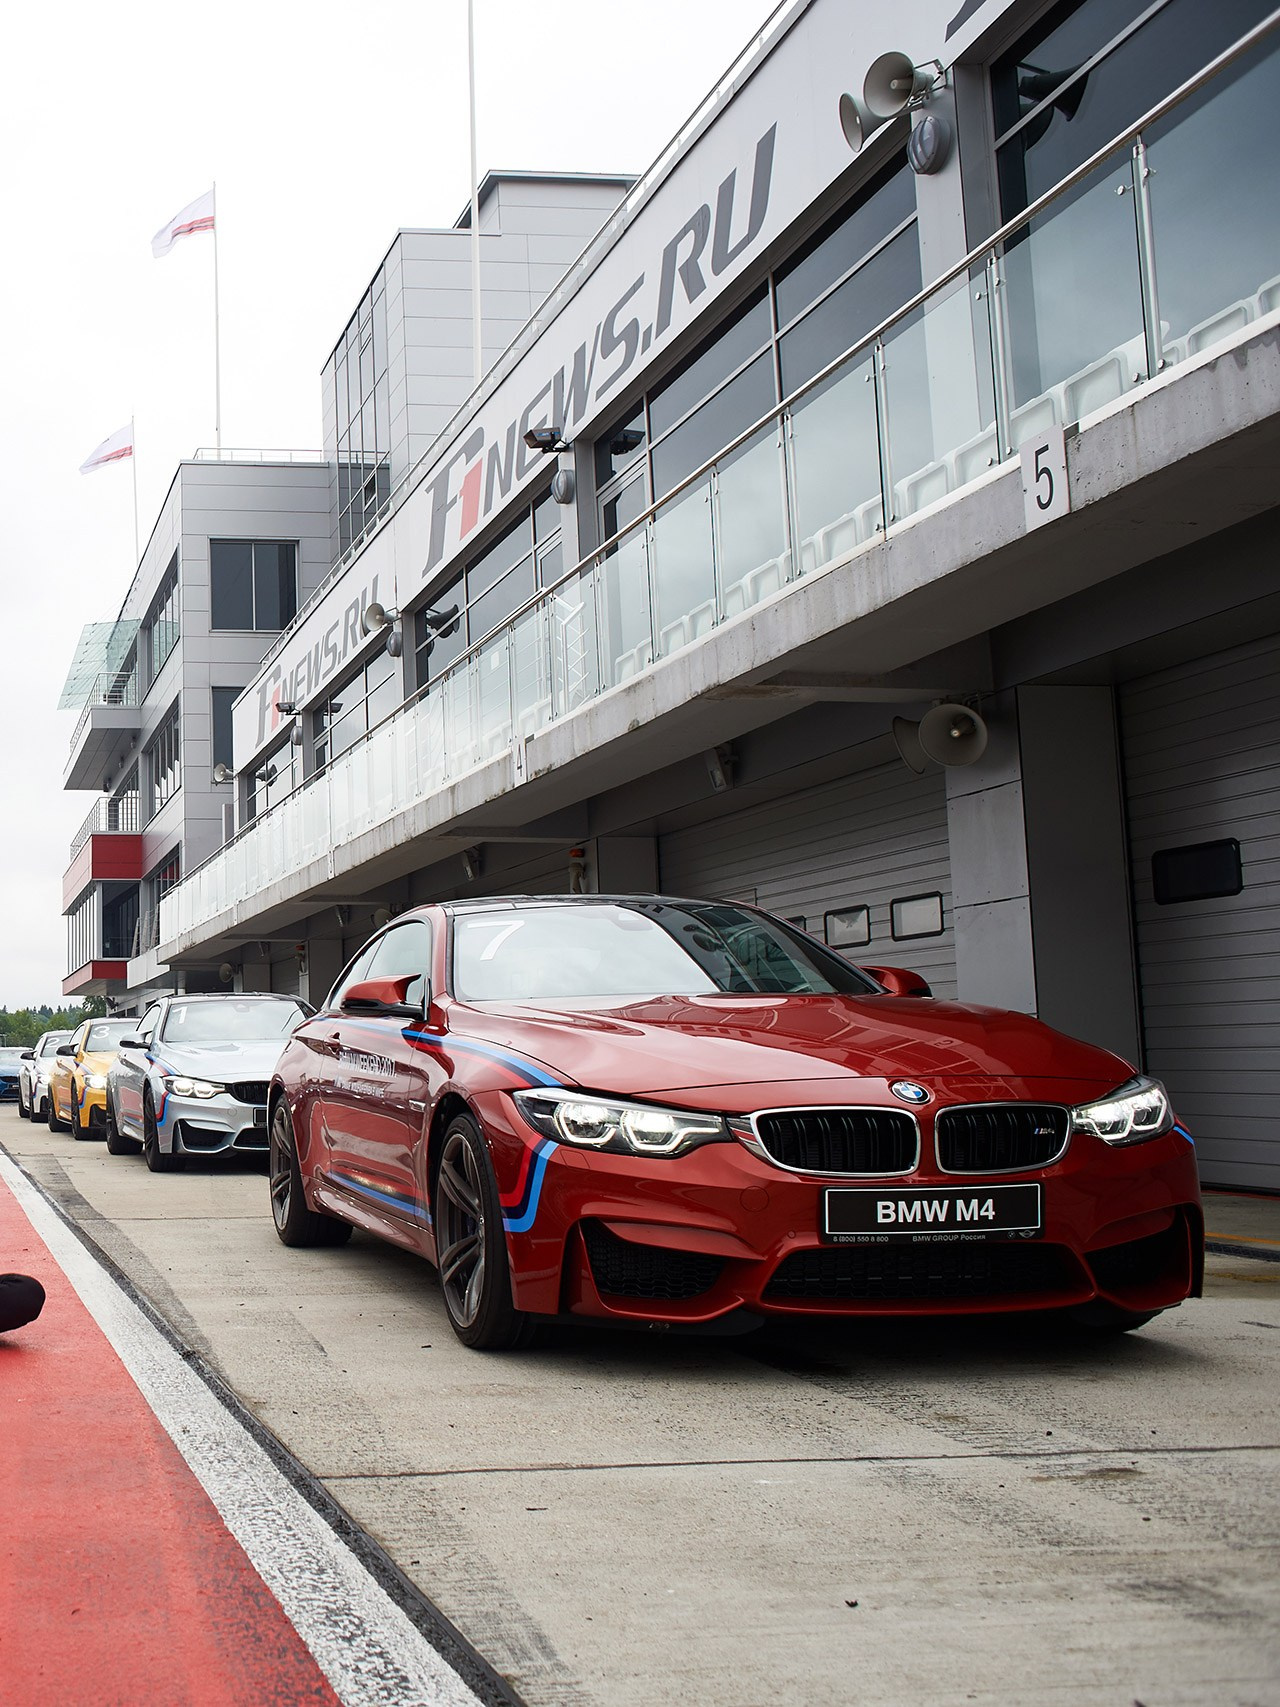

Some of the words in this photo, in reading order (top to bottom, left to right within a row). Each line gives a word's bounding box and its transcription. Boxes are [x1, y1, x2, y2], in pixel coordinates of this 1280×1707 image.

[1034, 443, 1054, 510] 5
[467, 920, 525, 960] 7
[172, 1006, 188, 1024] 1
[92, 1025, 110, 1039] 3
[45, 1037, 60, 1048] 2
[877, 1200, 949, 1223] BMW
[956, 1199, 996, 1221] M4
[932, 1234, 959, 1242] GROUP
